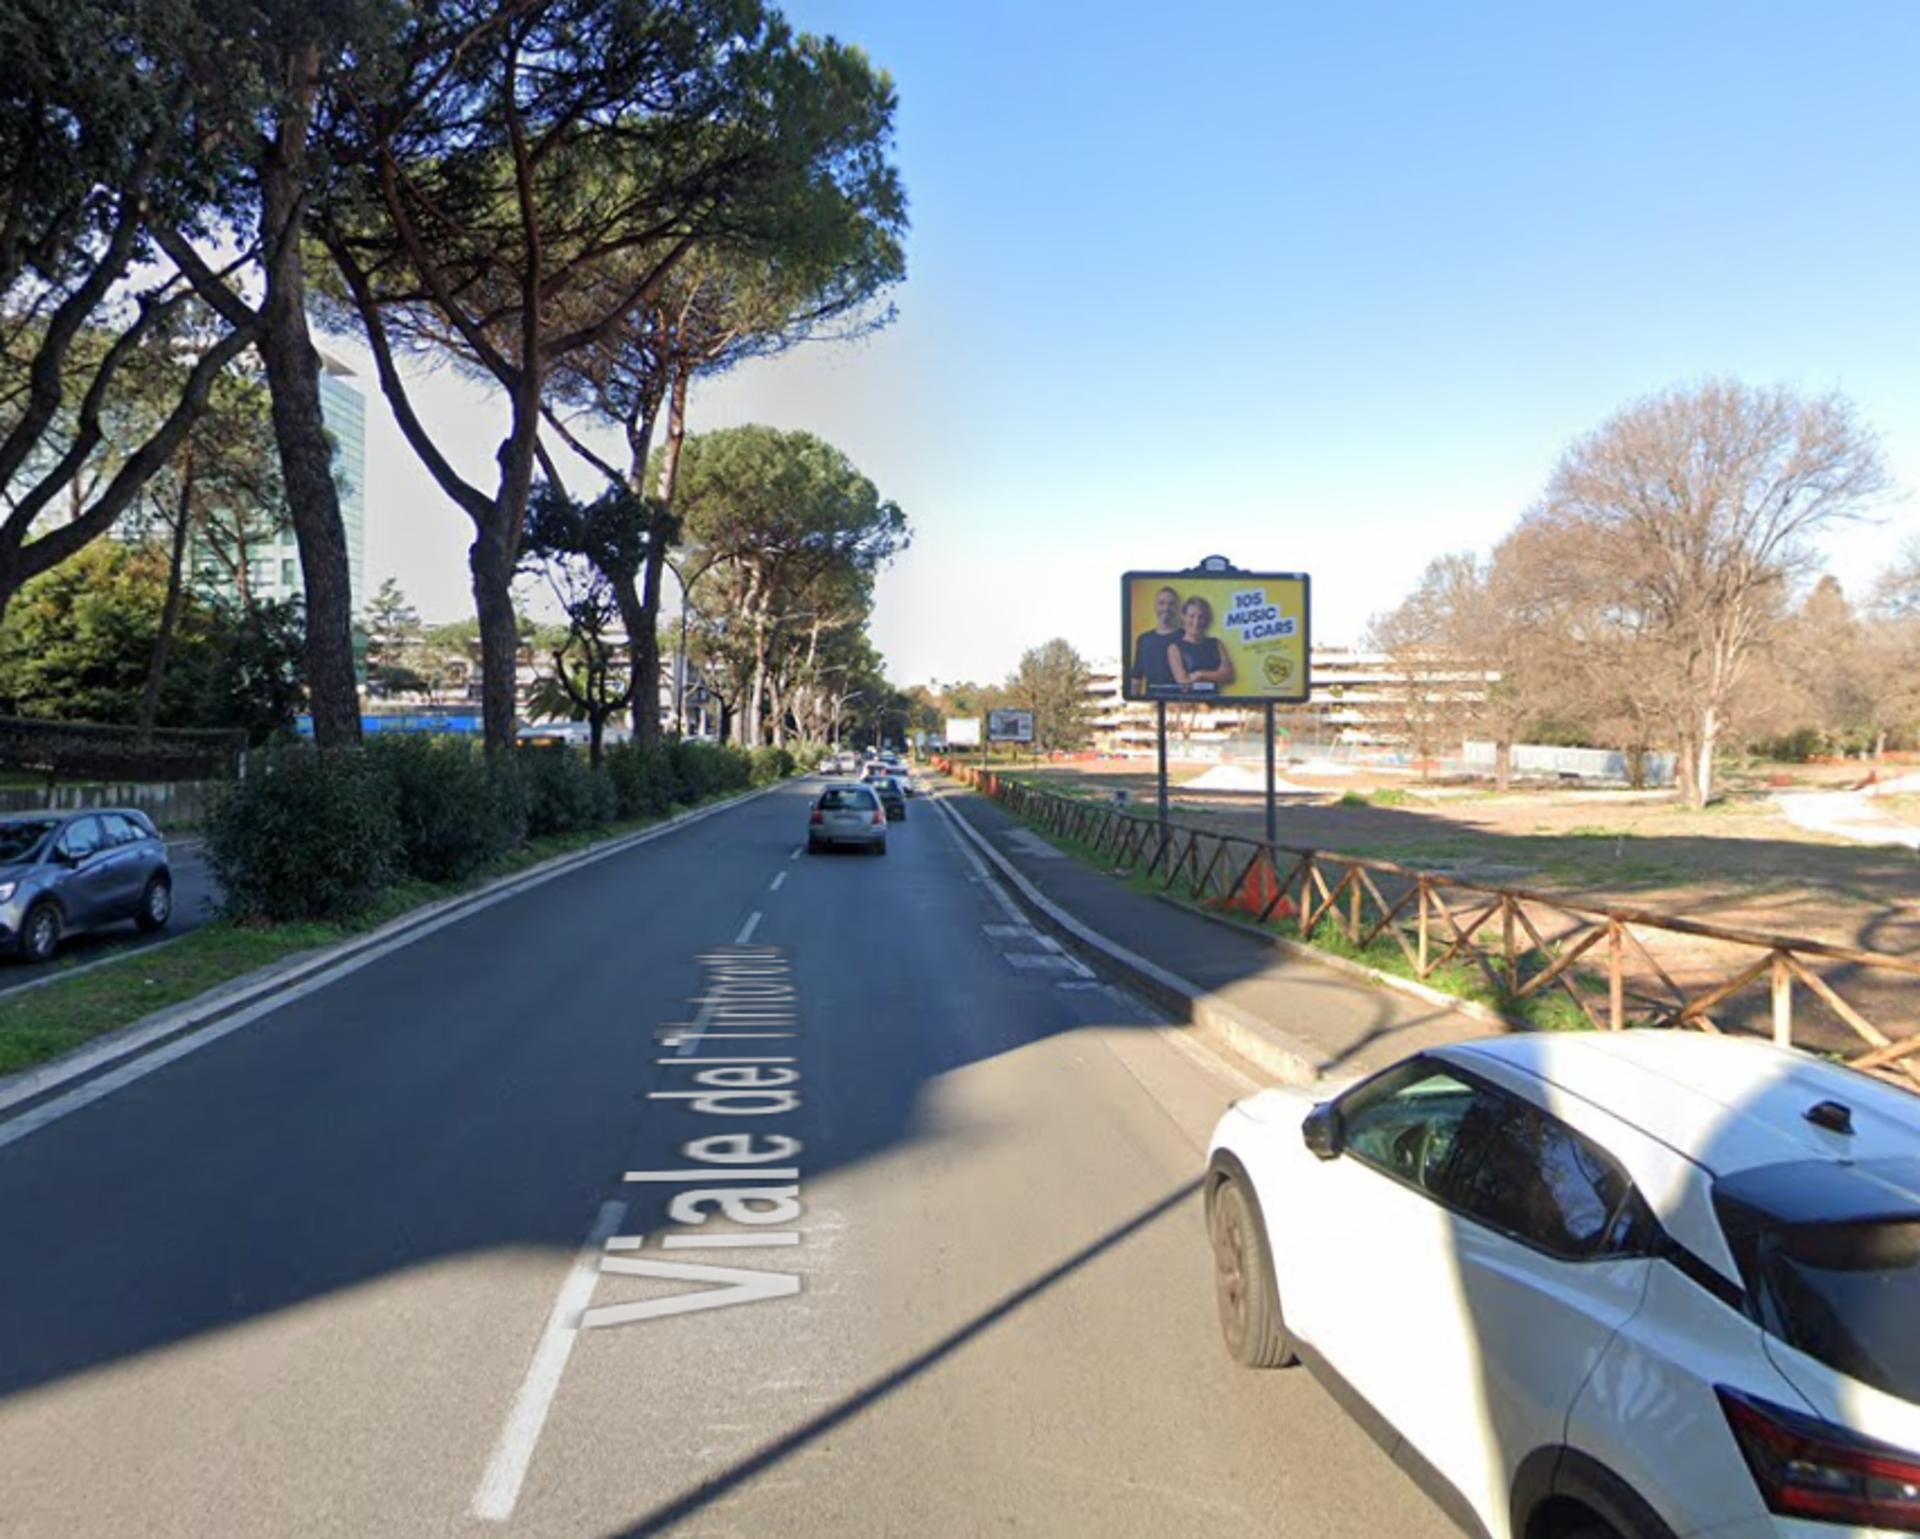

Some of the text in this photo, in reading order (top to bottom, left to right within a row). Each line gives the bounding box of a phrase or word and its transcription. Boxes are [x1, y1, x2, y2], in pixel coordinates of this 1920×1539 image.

[1235, 591, 1263, 609] 105
[1226, 606, 1277, 627] MUSIC
[1252, 619, 1294, 638] CARS
